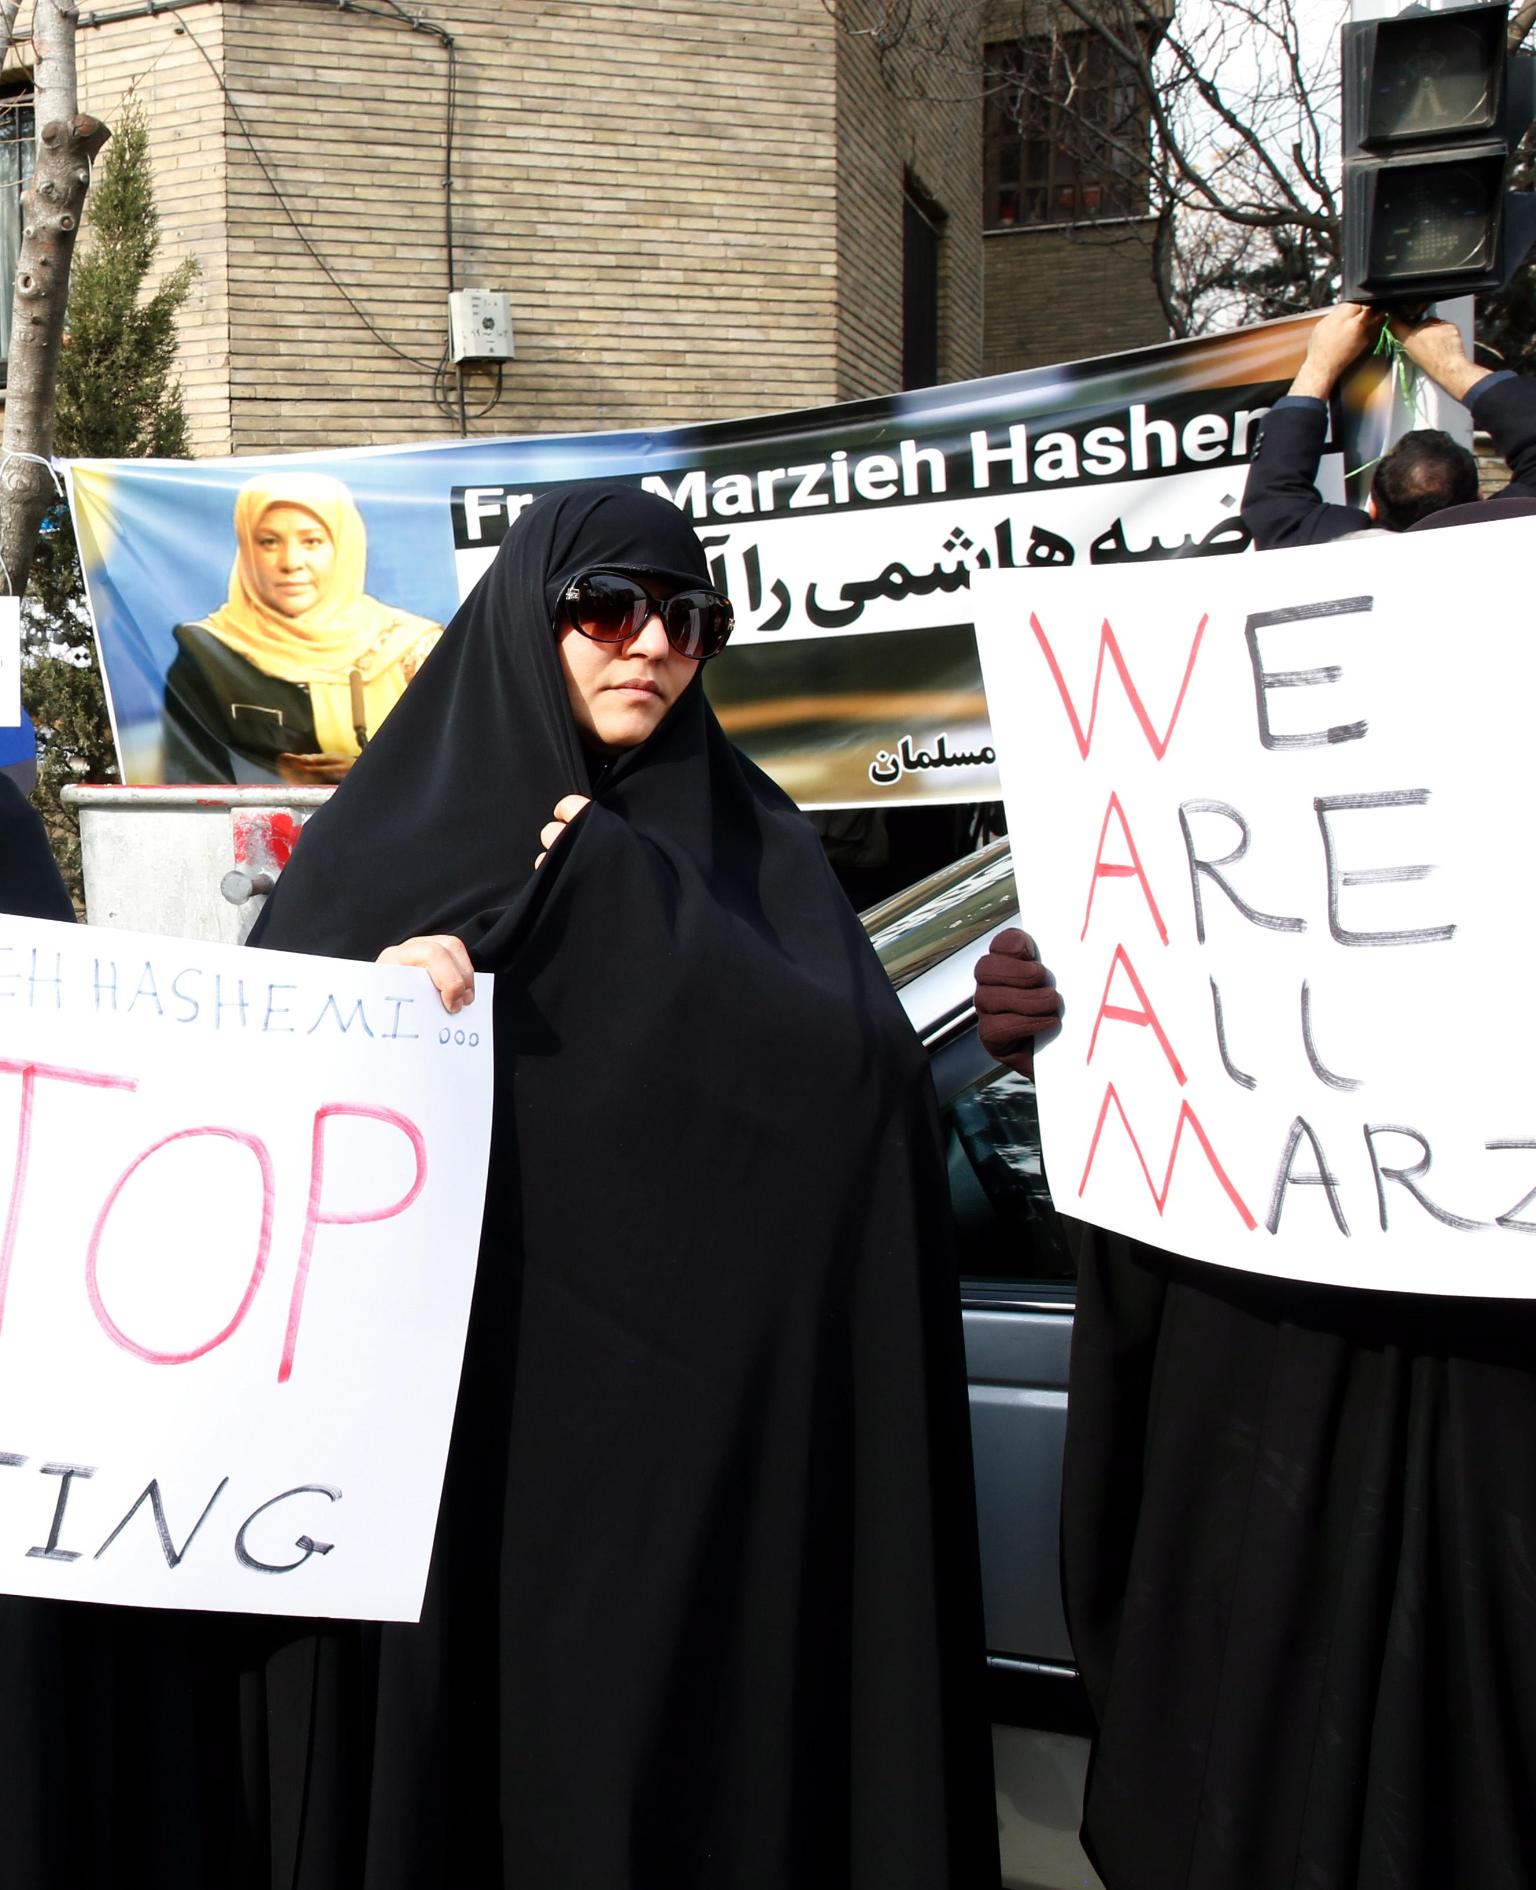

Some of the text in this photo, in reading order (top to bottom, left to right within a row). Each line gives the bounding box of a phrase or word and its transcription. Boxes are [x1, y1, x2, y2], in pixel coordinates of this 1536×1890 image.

[641, 439, 946, 519] Marzieh
[1030, 595, 1373, 760] WE
[870, 735, 997, 784] مسلمان
[1080, 788, 1457, 946] ARE
